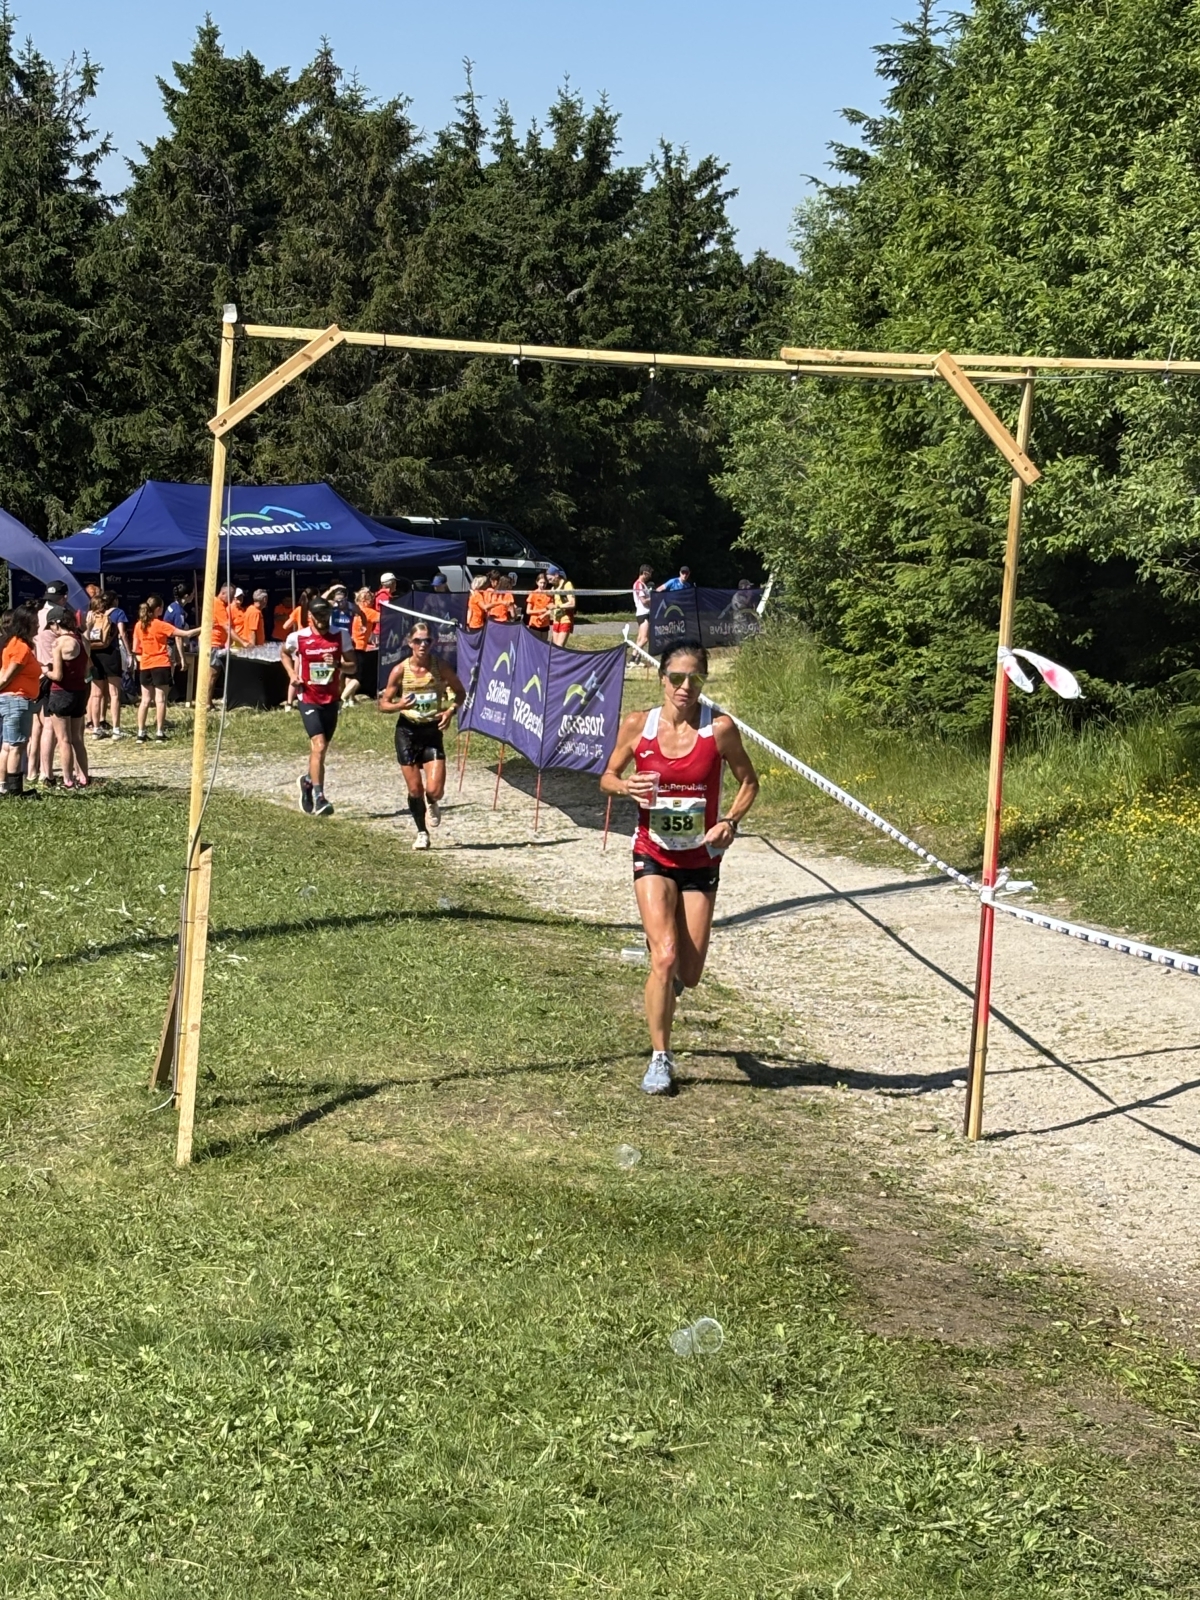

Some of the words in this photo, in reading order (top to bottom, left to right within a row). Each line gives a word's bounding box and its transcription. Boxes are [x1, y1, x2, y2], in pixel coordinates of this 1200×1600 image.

[252, 551, 333, 562] www.skiresort.cz
[415, 703, 431, 711] 219
[657, 783, 708, 792] chRepublic
[661, 815, 694, 831] 358
